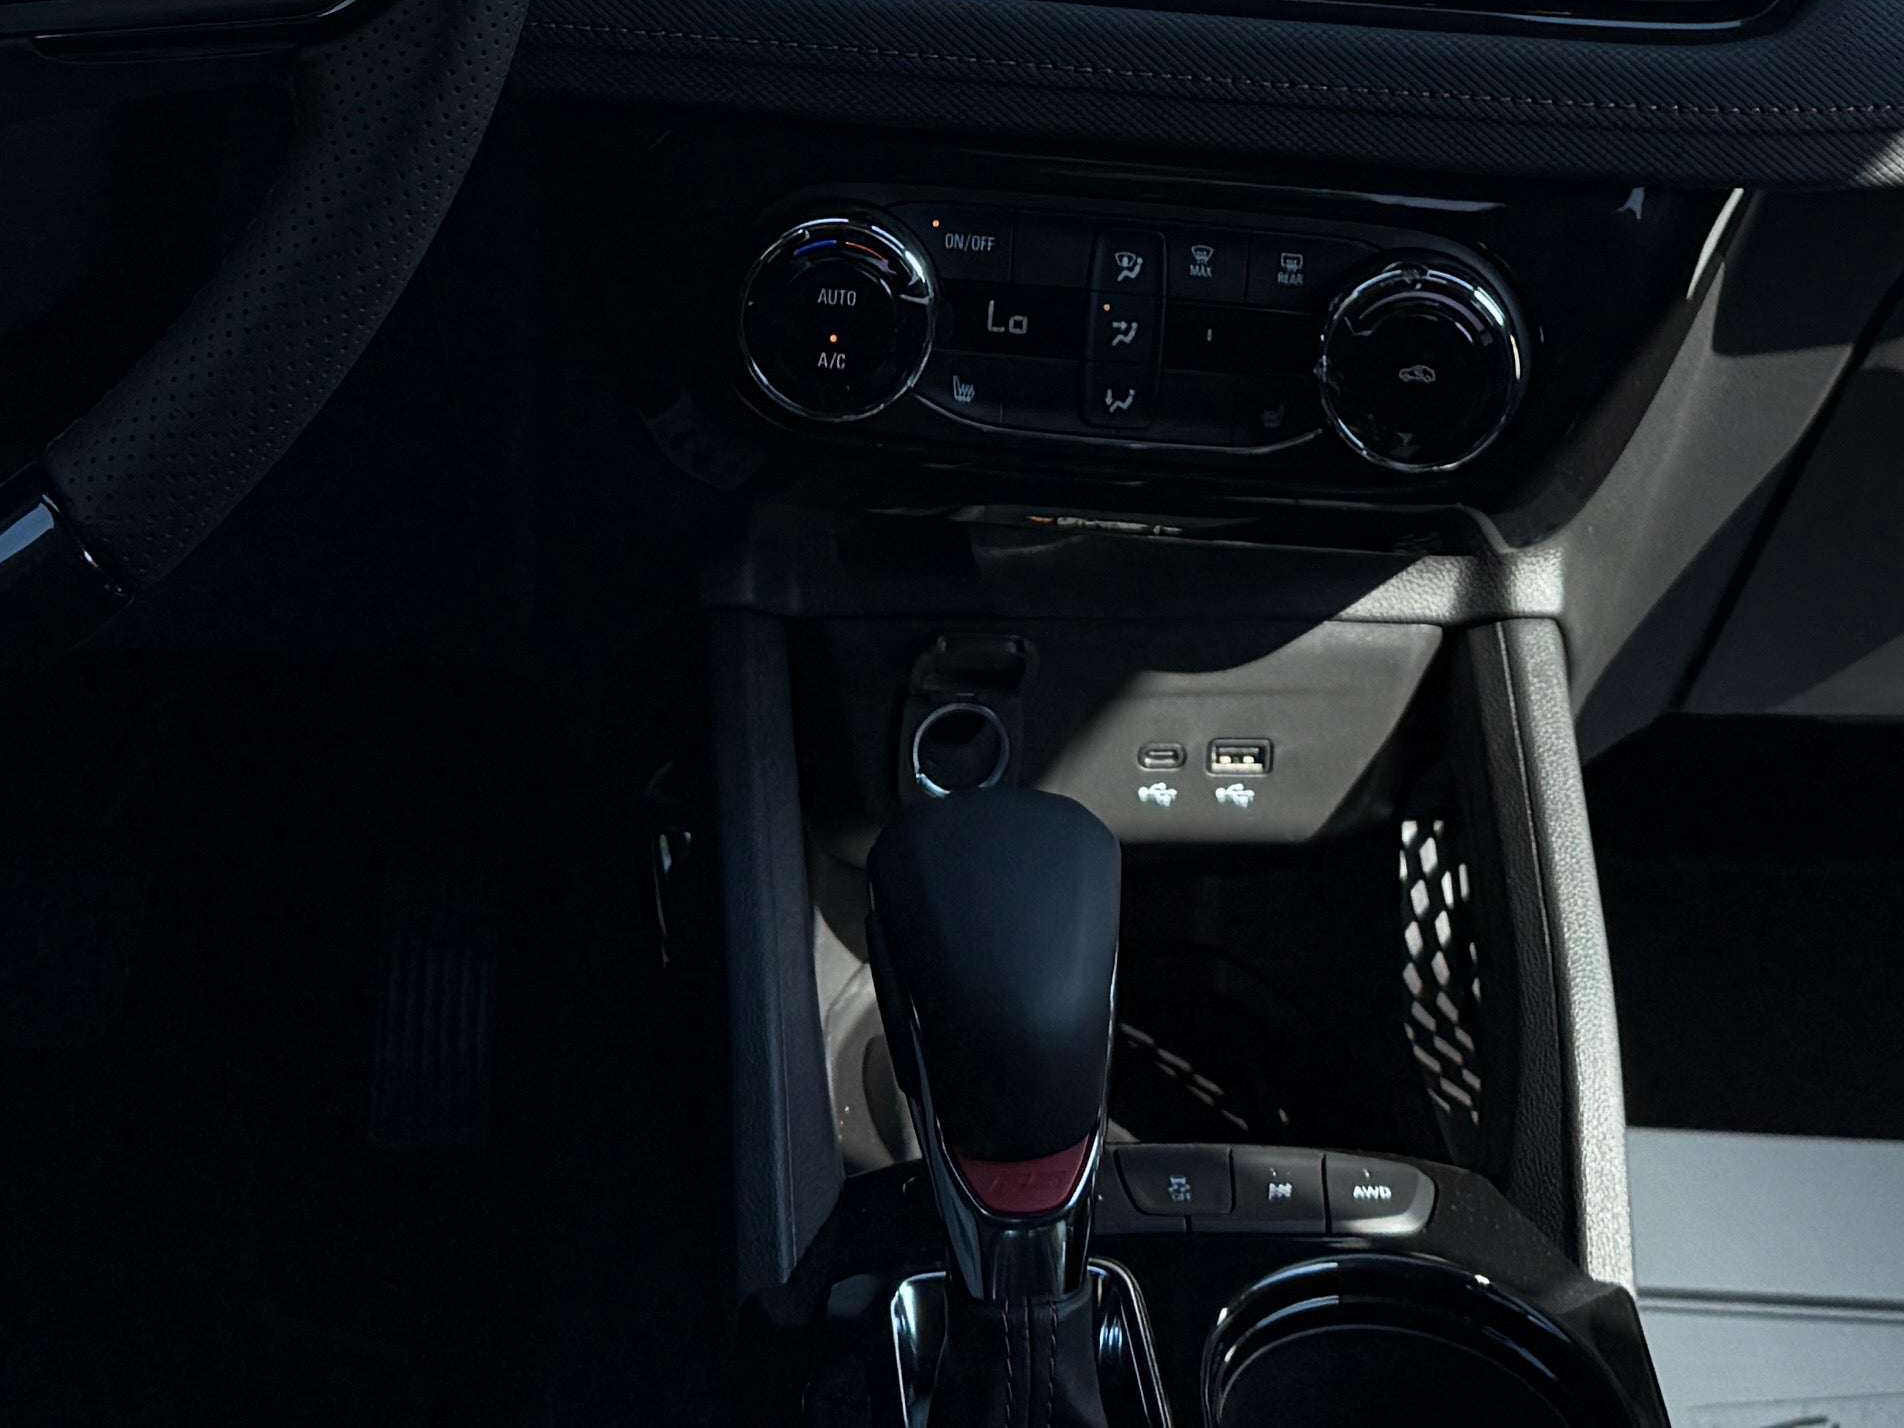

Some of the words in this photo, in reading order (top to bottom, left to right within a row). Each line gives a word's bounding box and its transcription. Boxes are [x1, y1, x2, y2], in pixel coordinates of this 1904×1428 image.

[945, 232, 995, 252] ON/OFF
[817, 287, 857, 307] AUTO
[817, 351, 846, 370] A/C
[1353, 1185, 1391, 1202] AWD
